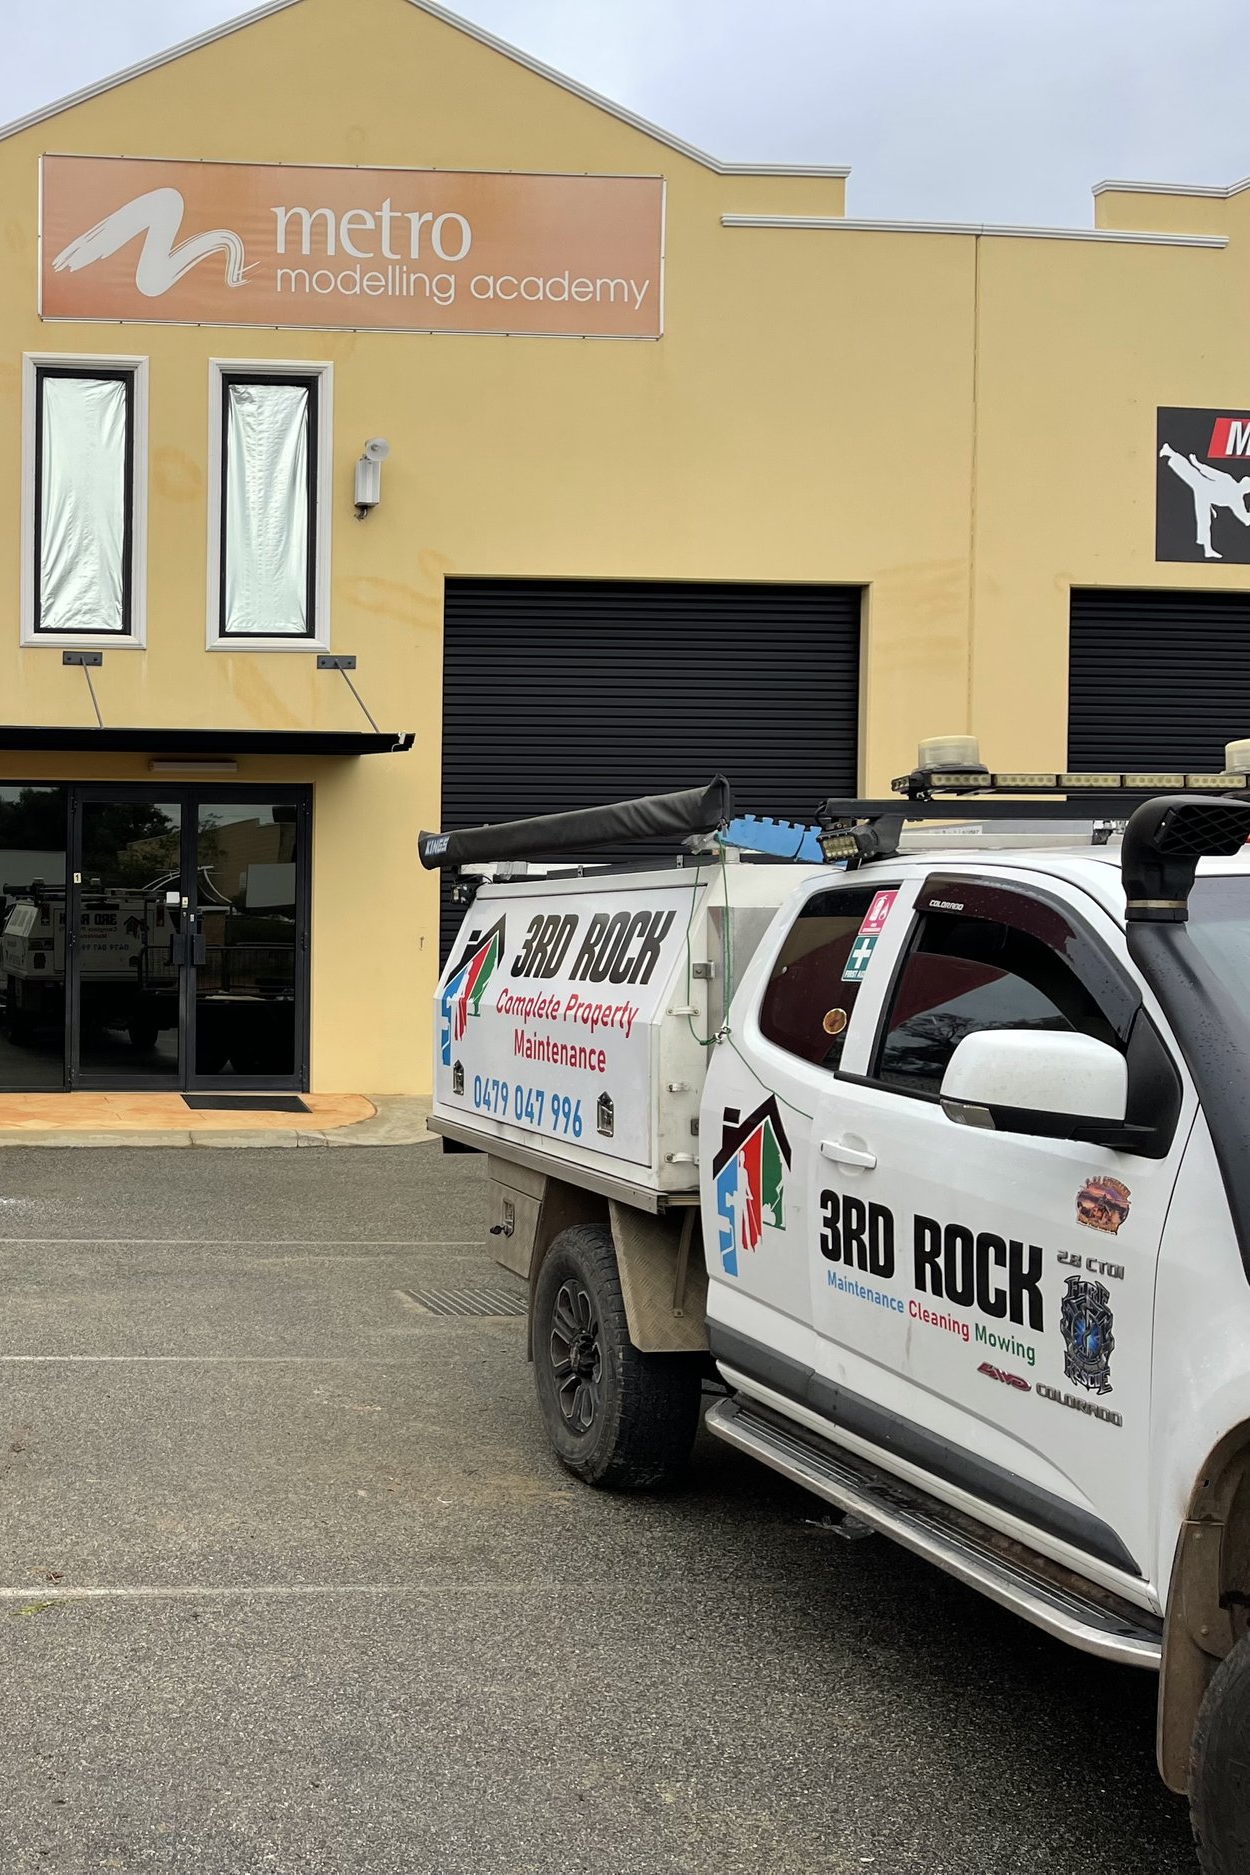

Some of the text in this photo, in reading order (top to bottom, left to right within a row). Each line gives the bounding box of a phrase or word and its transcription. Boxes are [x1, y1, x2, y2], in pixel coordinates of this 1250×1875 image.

[270, 197, 472, 262] metro
[276, 265, 650, 310] modelling academy
[929, 899, 964, 911] COLORADO
[510, 910, 677, 985] 3RD ROCK
[495, 988, 639, 1038] Complete Property
[513, 1029, 607, 1073] Maintenance
[473, 1075, 583, 1138] 0479 047 996
[820, 1189, 1045, 1333] 3RD ROCK
[827, 1269, 1036, 1367] Maintenance Cleaning Mowing
[1036, 1382, 1123, 1428] COLORADO
